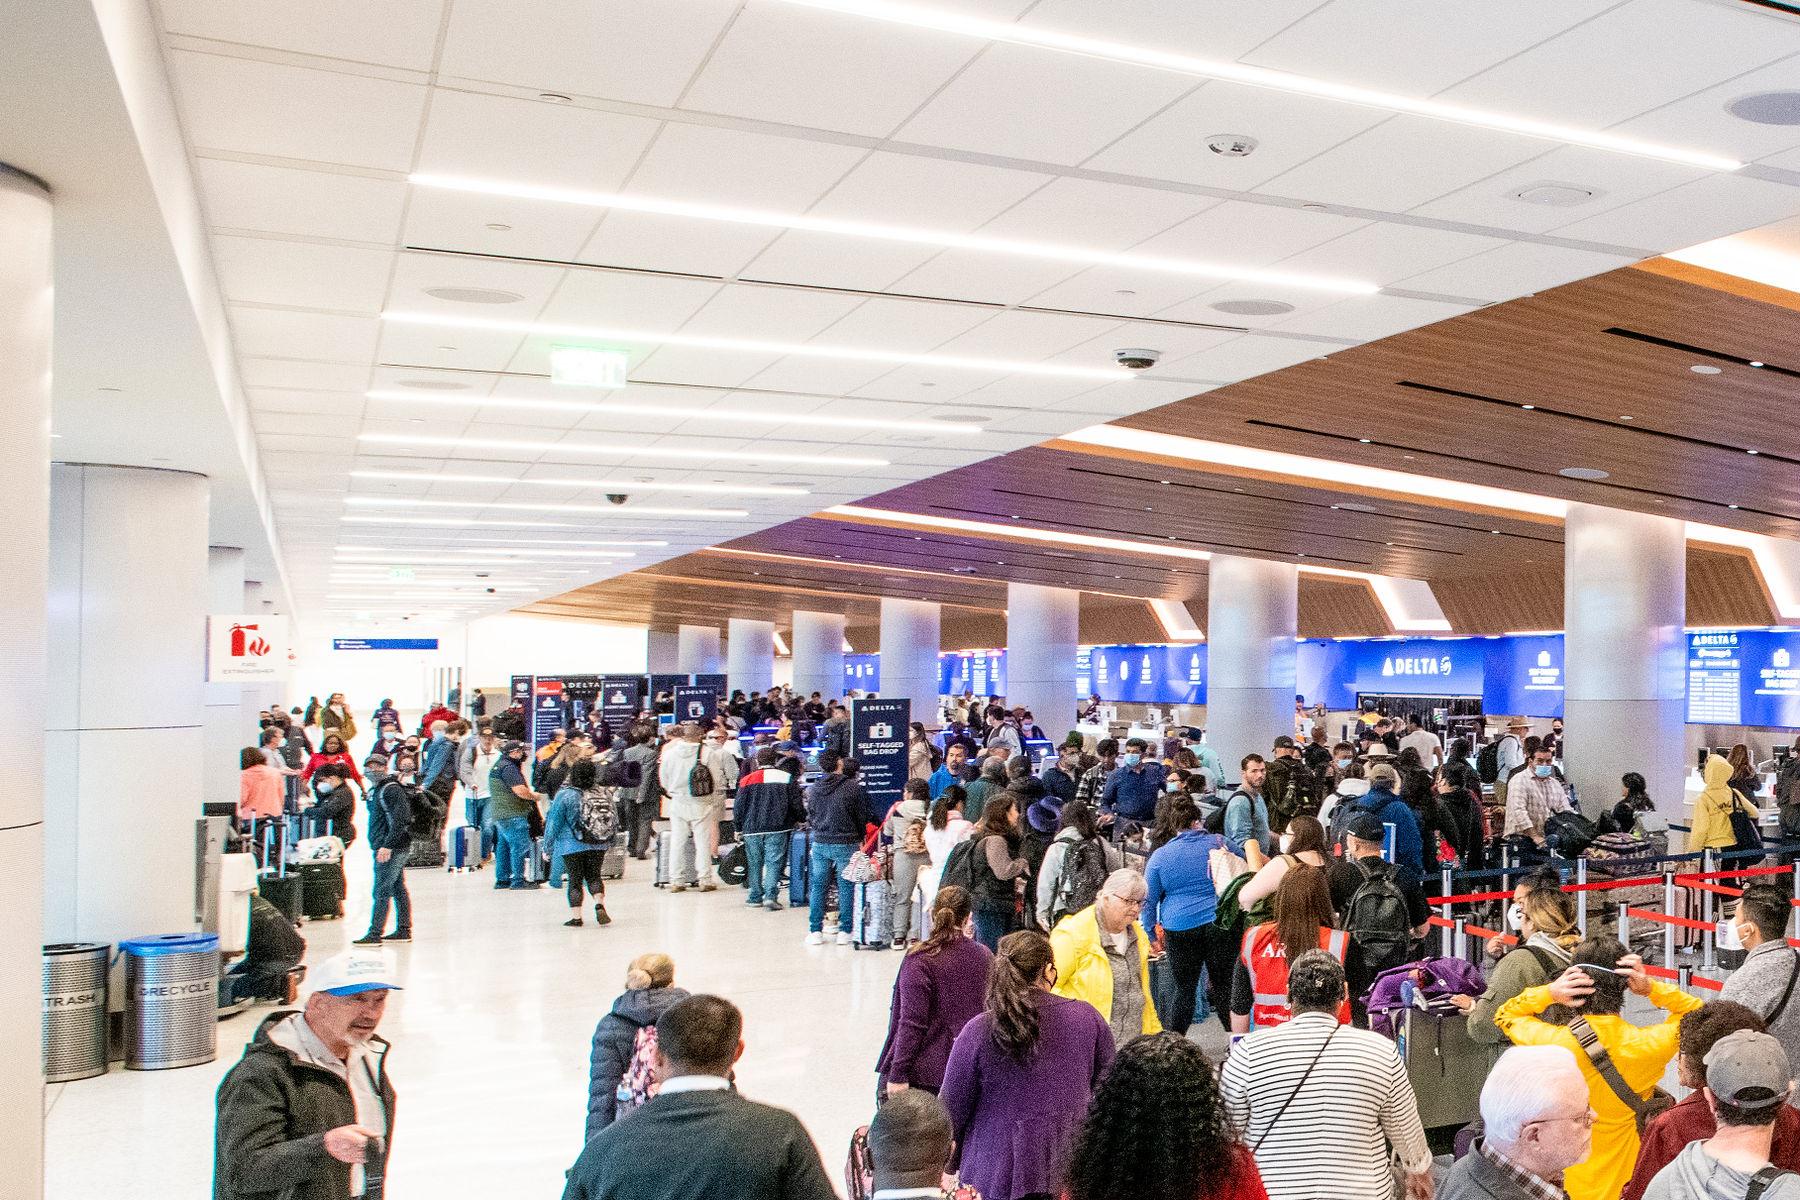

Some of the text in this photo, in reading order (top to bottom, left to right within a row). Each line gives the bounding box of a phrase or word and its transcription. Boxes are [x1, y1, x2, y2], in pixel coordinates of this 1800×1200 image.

[1698, 634, 1730, 646] DELTA
[1395, 658, 1438, 675] DELTA
[857, 741, 905, 749] SELF-TAGGED
[863, 748, 878, 756] BAG
[150, 981, 210, 996] RECYCLE
[45, 992, 96, 1008] TRASH
